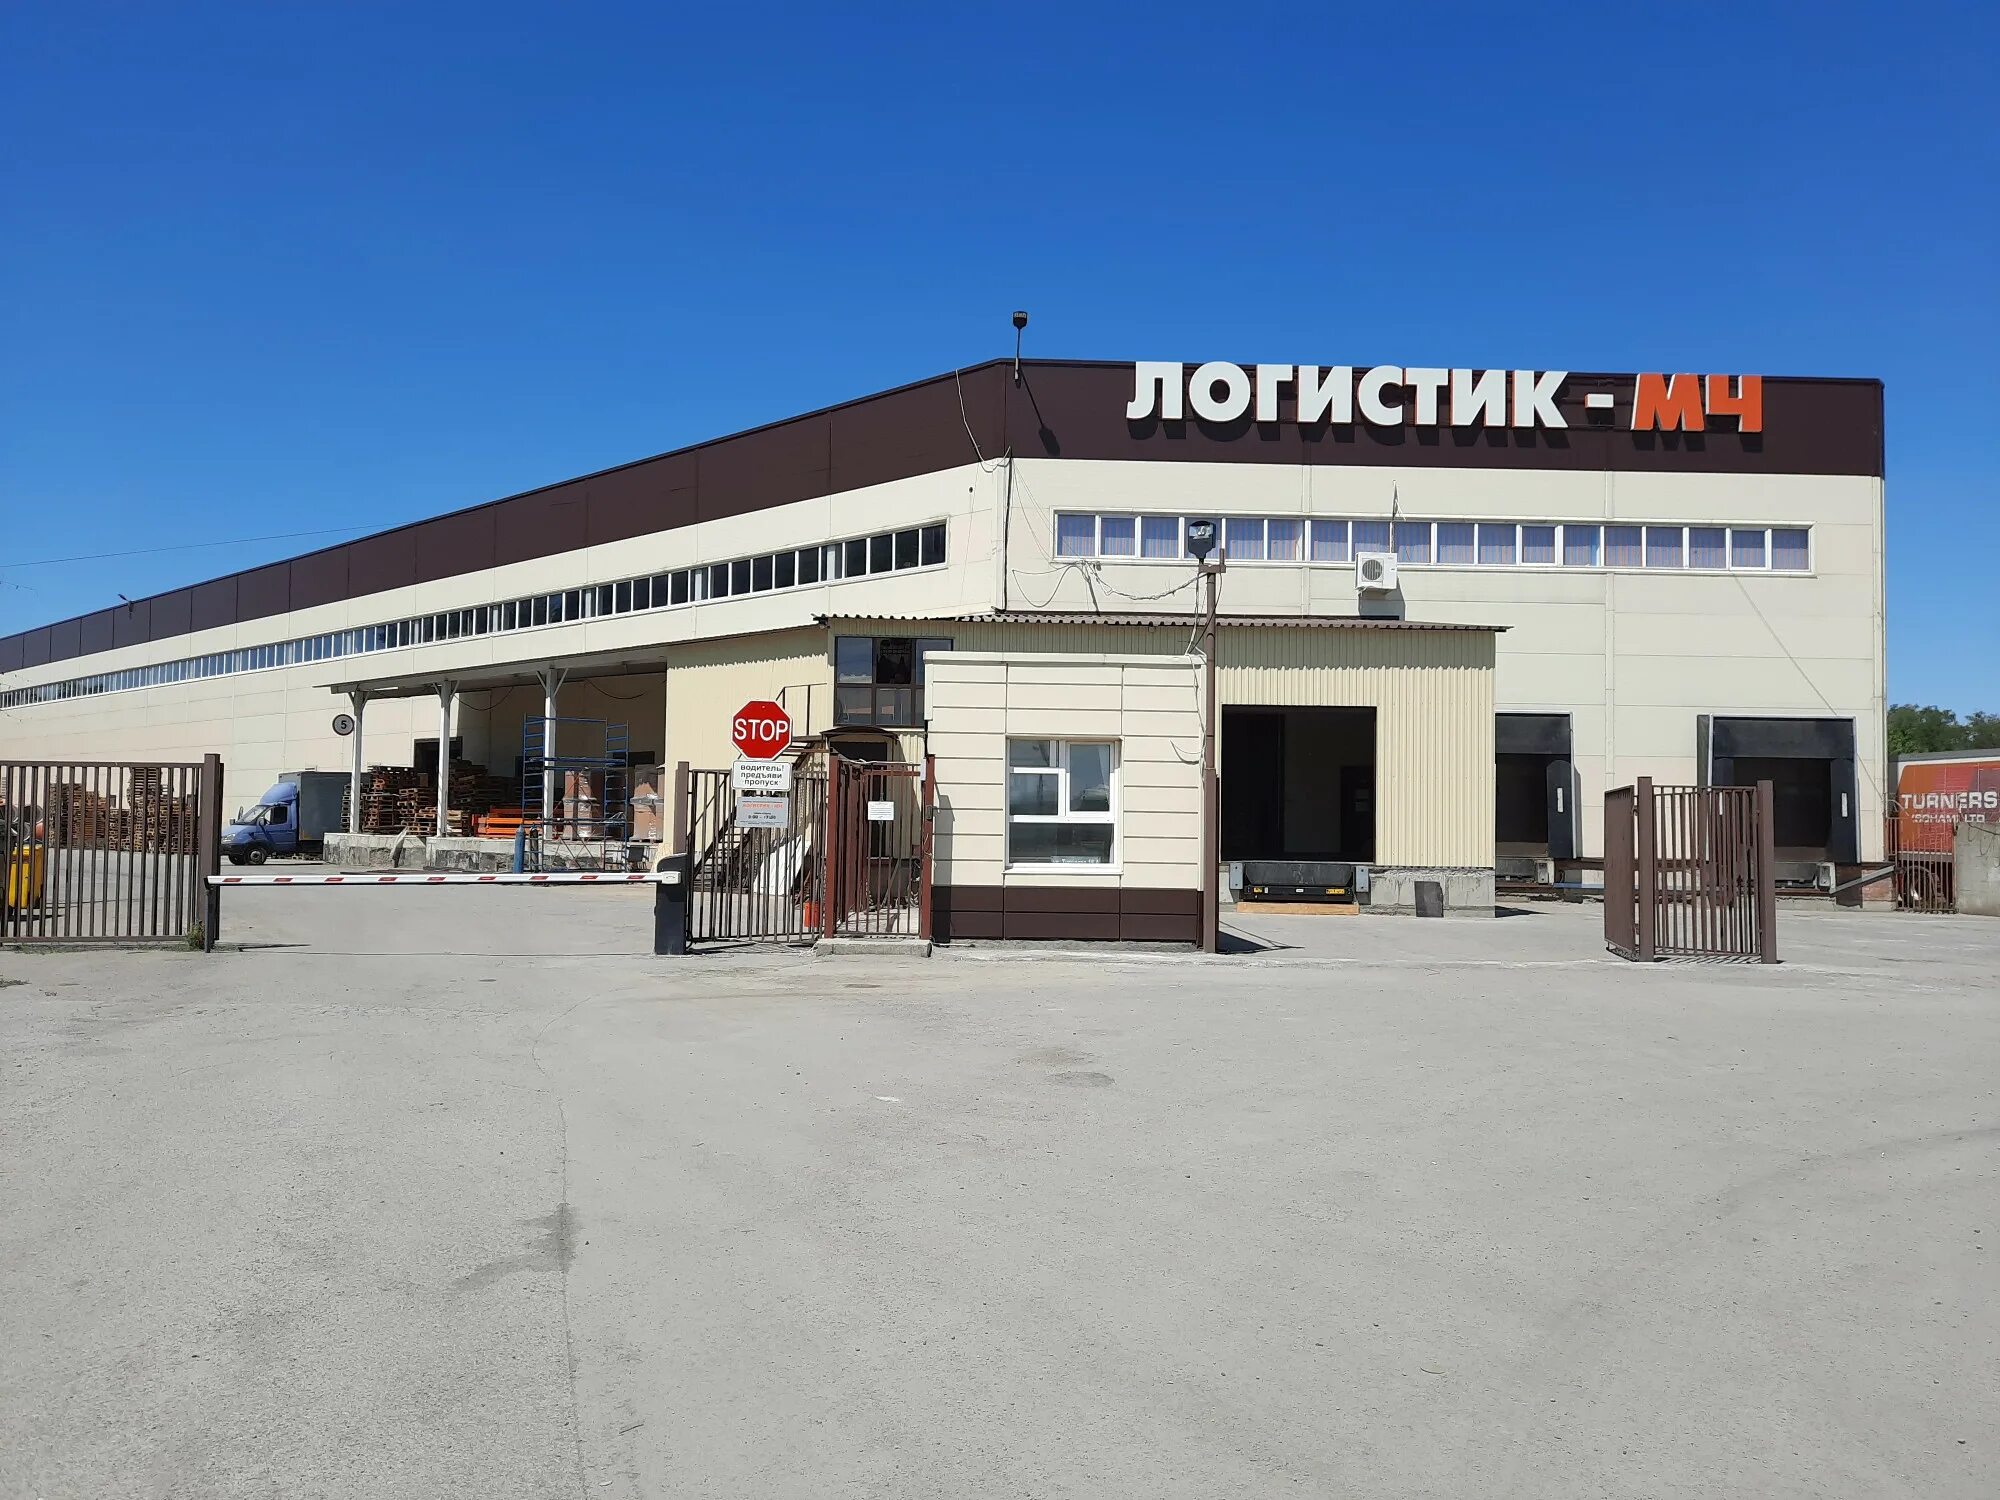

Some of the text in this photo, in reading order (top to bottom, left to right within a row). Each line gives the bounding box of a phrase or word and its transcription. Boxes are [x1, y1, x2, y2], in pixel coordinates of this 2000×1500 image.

[1126, 361, 1568, 428] ЛОГИСТИК
[1630, 372, 1763, 432] МЧ
[341, 720, 347, 729] 5
[734, 718, 789, 741] STOP
[744, 779, 779, 787] пропуск
[1901, 791, 1998, 809] TURNERS
[1964, 814, 1986, 823] LTD
